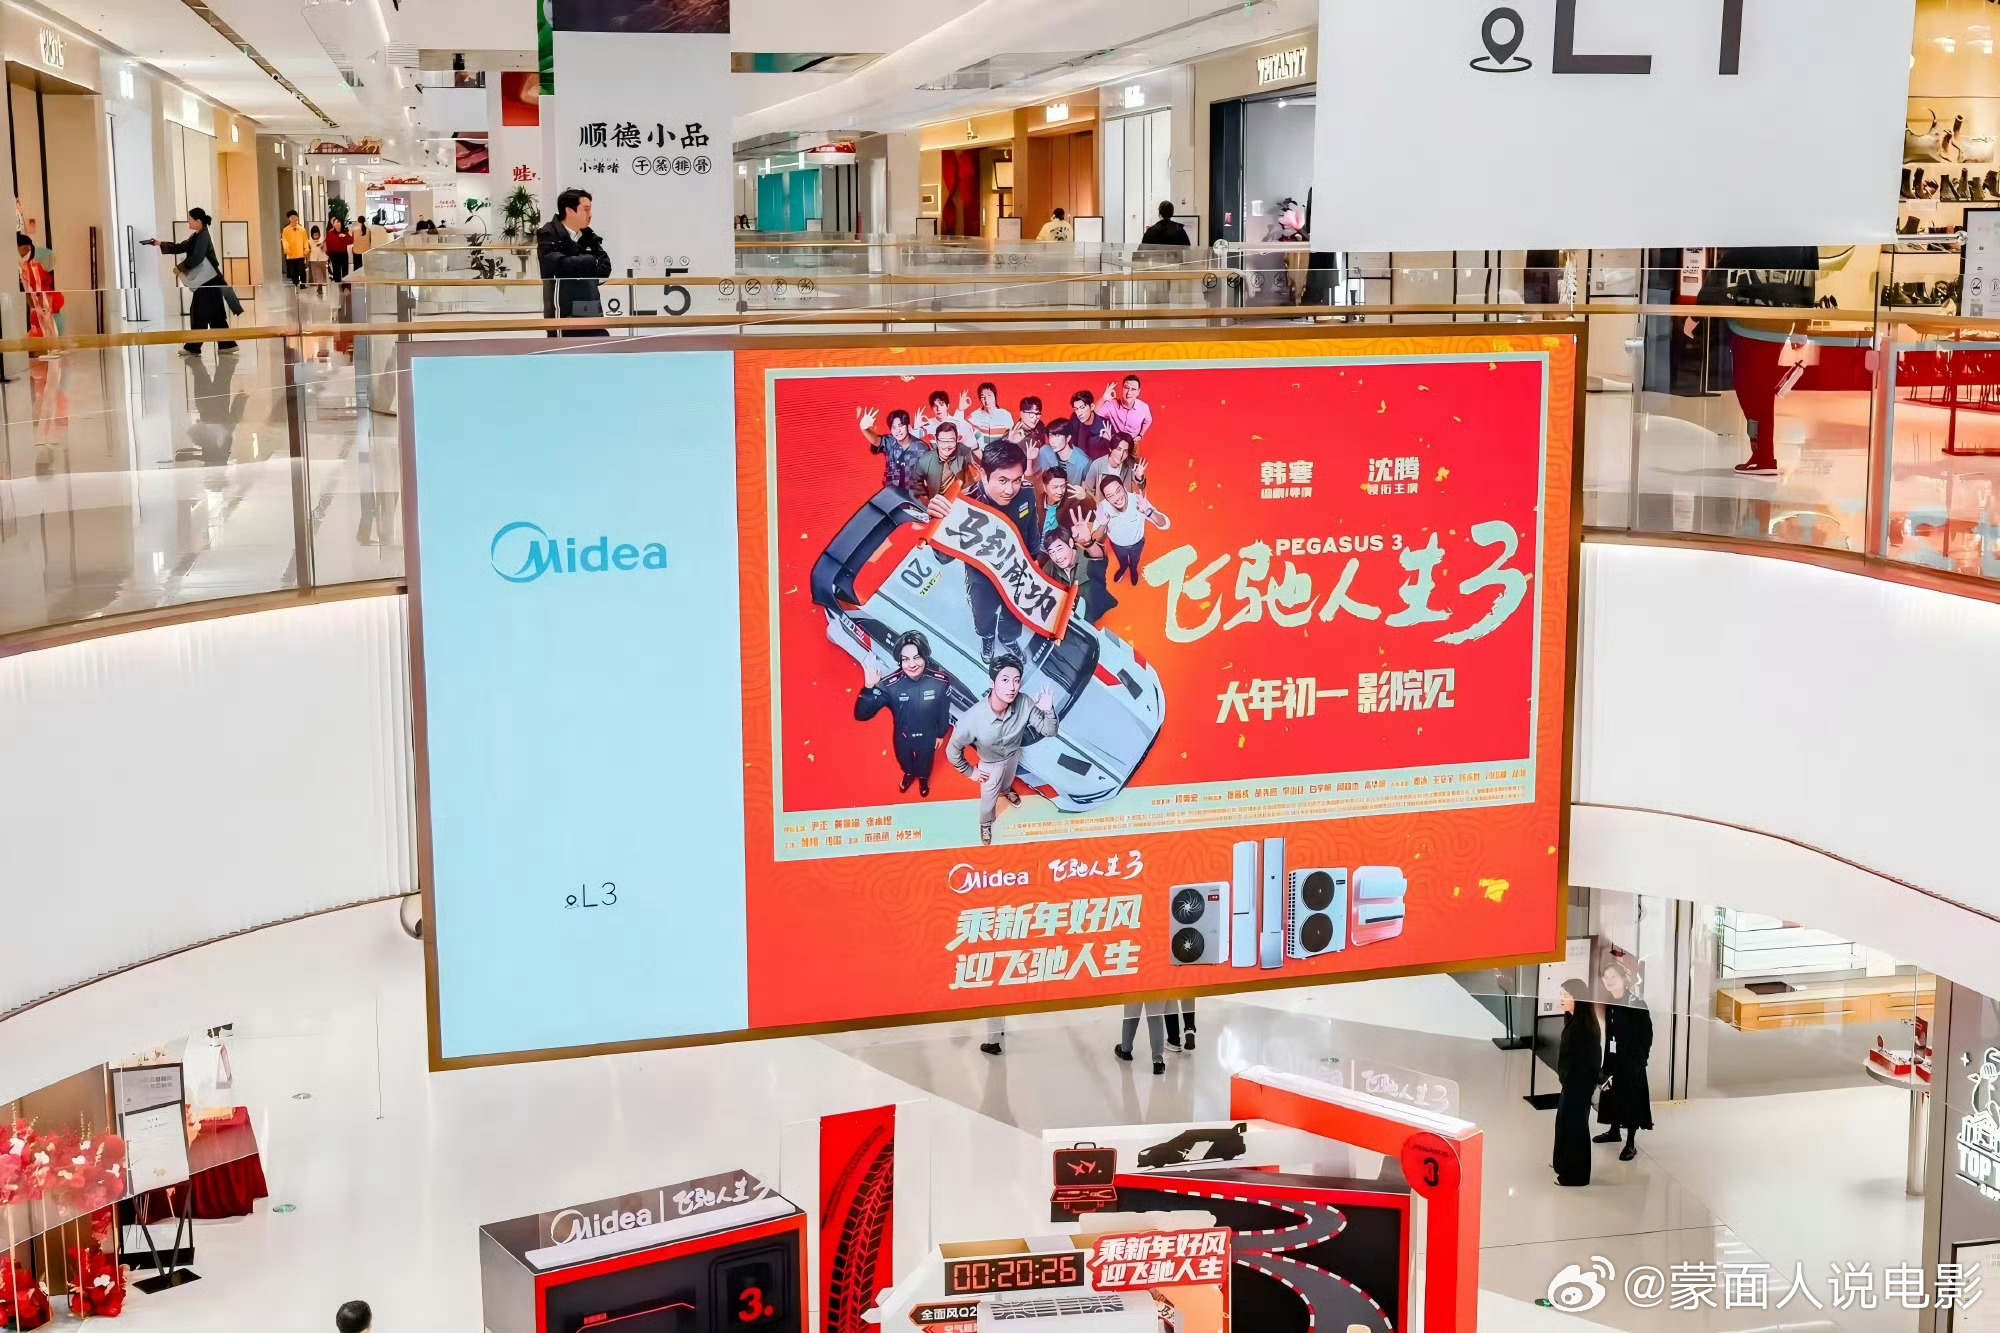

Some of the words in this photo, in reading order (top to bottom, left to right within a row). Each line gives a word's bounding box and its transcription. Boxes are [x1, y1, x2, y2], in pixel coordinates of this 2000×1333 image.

[579, 122, 709, 149] 顺德小品
[513, 164, 541, 181] 蛙
[632, 155, 712, 175] 干蒸排骨
[627, 268, 692, 316] L5
[1261, 460, 1314, 485] 韩寒
[1368, 457, 1420, 482] 沈腾
[491, 526, 668, 580] Midea
[1275, 537, 1384, 556] PEGASUS
[1391, 534, 1403, 551] 3
[1216, 677, 1349, 724] 大年初一
[1358, 668, 1455, 713] 影院见
[949, 866, 1029, 891] Midea
[1048, 850, 1144, 882] 飞驰人生3
[583, 882, 617, 907] L3
[945, 894, 1142, 950] 乘新年好风
[949, 940, 1141, 990] 迎飞驰人生
[1424, 1157, 1440, 1187] 3
[1958, 1142, 1992, 1181] TOP
[551, 1209, 652, 1244] Midea
[1099, 1231, 1226, 1263] 乘新年好风
[954, 1256, 1076, 1290] 00:20:26
[1100, 1254, 1224, 1286] 迎飞驰人生
